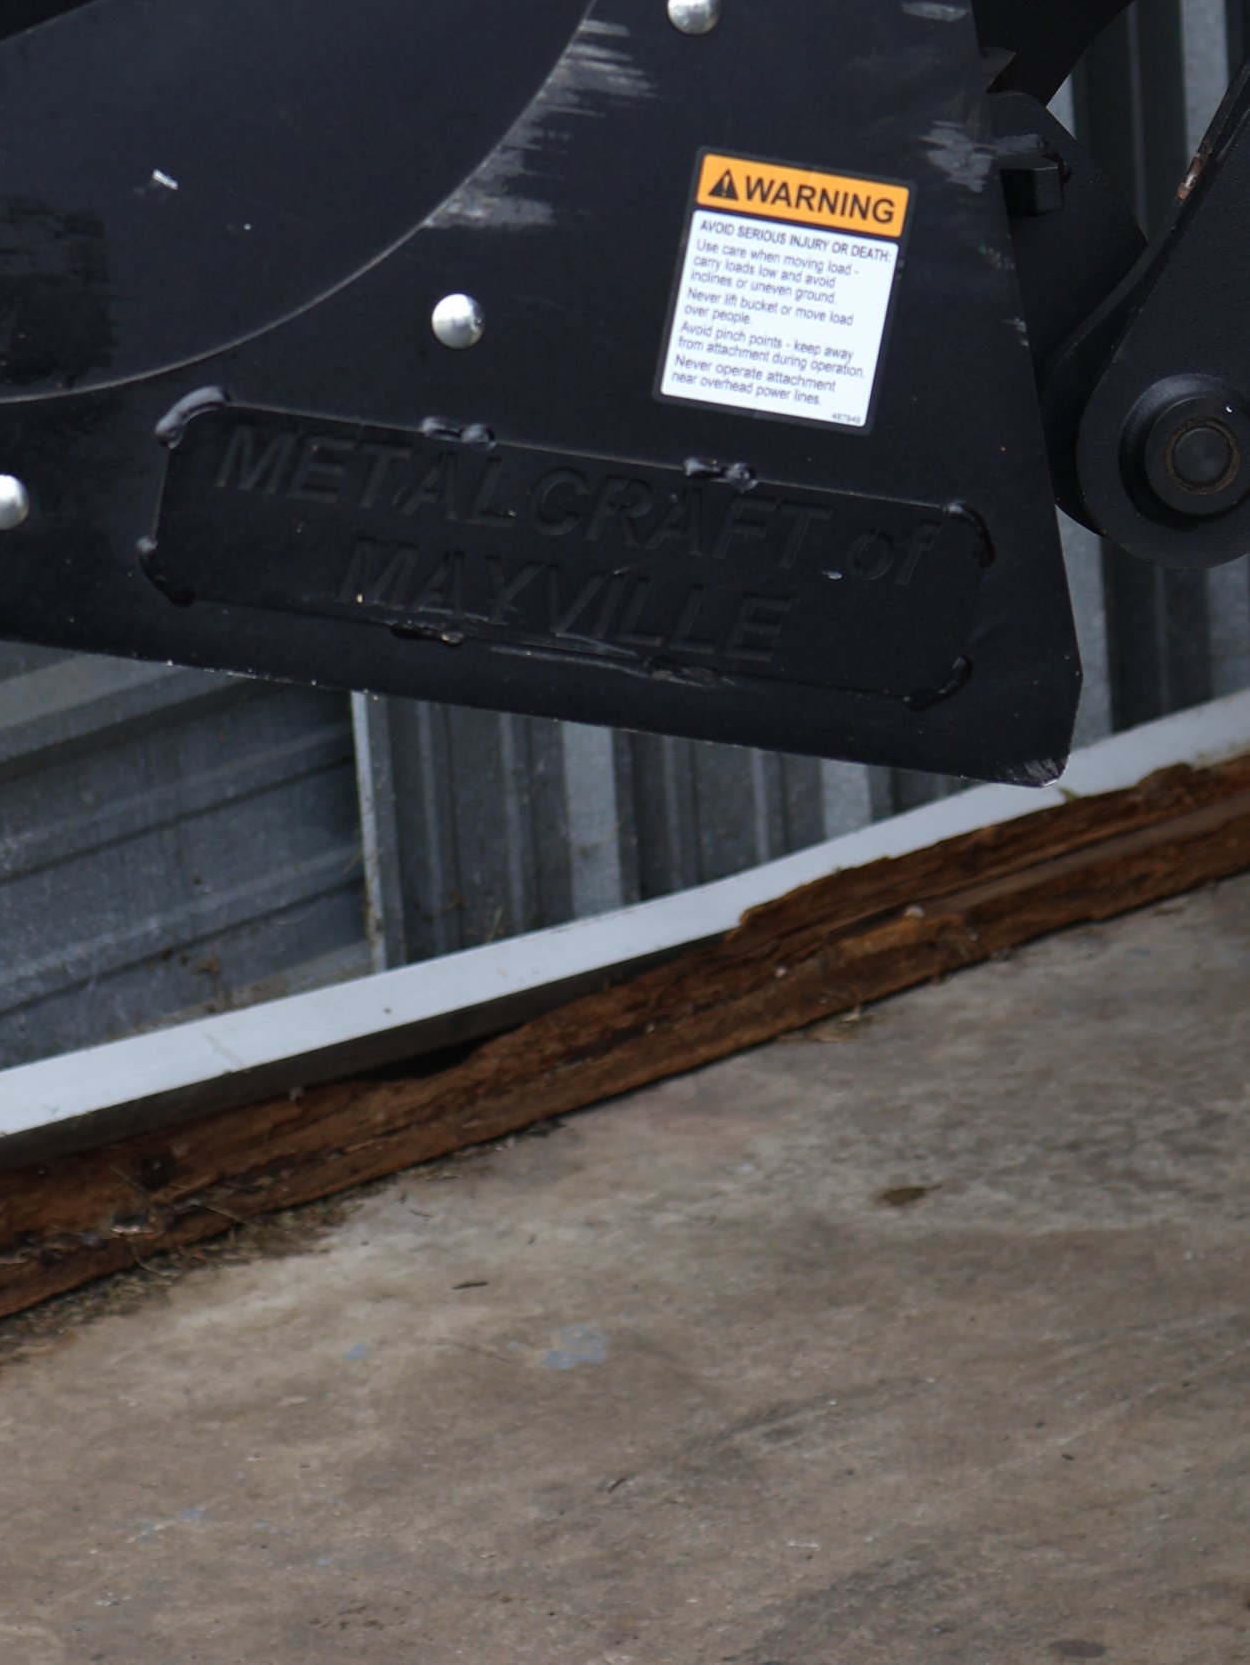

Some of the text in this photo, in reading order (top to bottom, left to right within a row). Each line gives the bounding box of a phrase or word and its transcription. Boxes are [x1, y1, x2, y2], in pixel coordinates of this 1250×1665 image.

[745, 175, 896, 225] WARNING
[700, 219, 734, 235] AVOID
[737, 225, 786, 244] SERIOUS
[789, 234, 829, 250] INJURY
[831, 241, 848, 254] OR
[693, 256, 835, 288] carry loads low and avoid
[696, 239, 718, 253] Use
[721, 245, 747, 258] care
[750, 249, 780, 262] when
[783, 255, 824, 274] moving
[827, 261, 851, 275] load
[690, 271, 732, 287] inclines
[735, 278, 748, 289] or
[750, 282, 792, 295] uneven
[684, 304, 709, 316] over
[688, 287, 853, 326] Never lift bucket or move load
[678, 335, 703, 349] from
[706, 342, 769, 361] attachment
[771, 352, 807, 371] during
[680, 320, 712, 337] Avoid
[714, 327, 745, 341] pinch
[748, 334, 782, 349] points
[793, 340, 821, 356] keep
[823, 346, 853, 364] away
[672, 371, 697, 384] near
[700, 376, 753, 394] overhead
[755, 385, 790, 399] power
[675, 354, 835, 391] Never operate attachment
[213, 423, 833, 569] METALCRAFT
[333, 535, 793, 663] MAYVILLE
